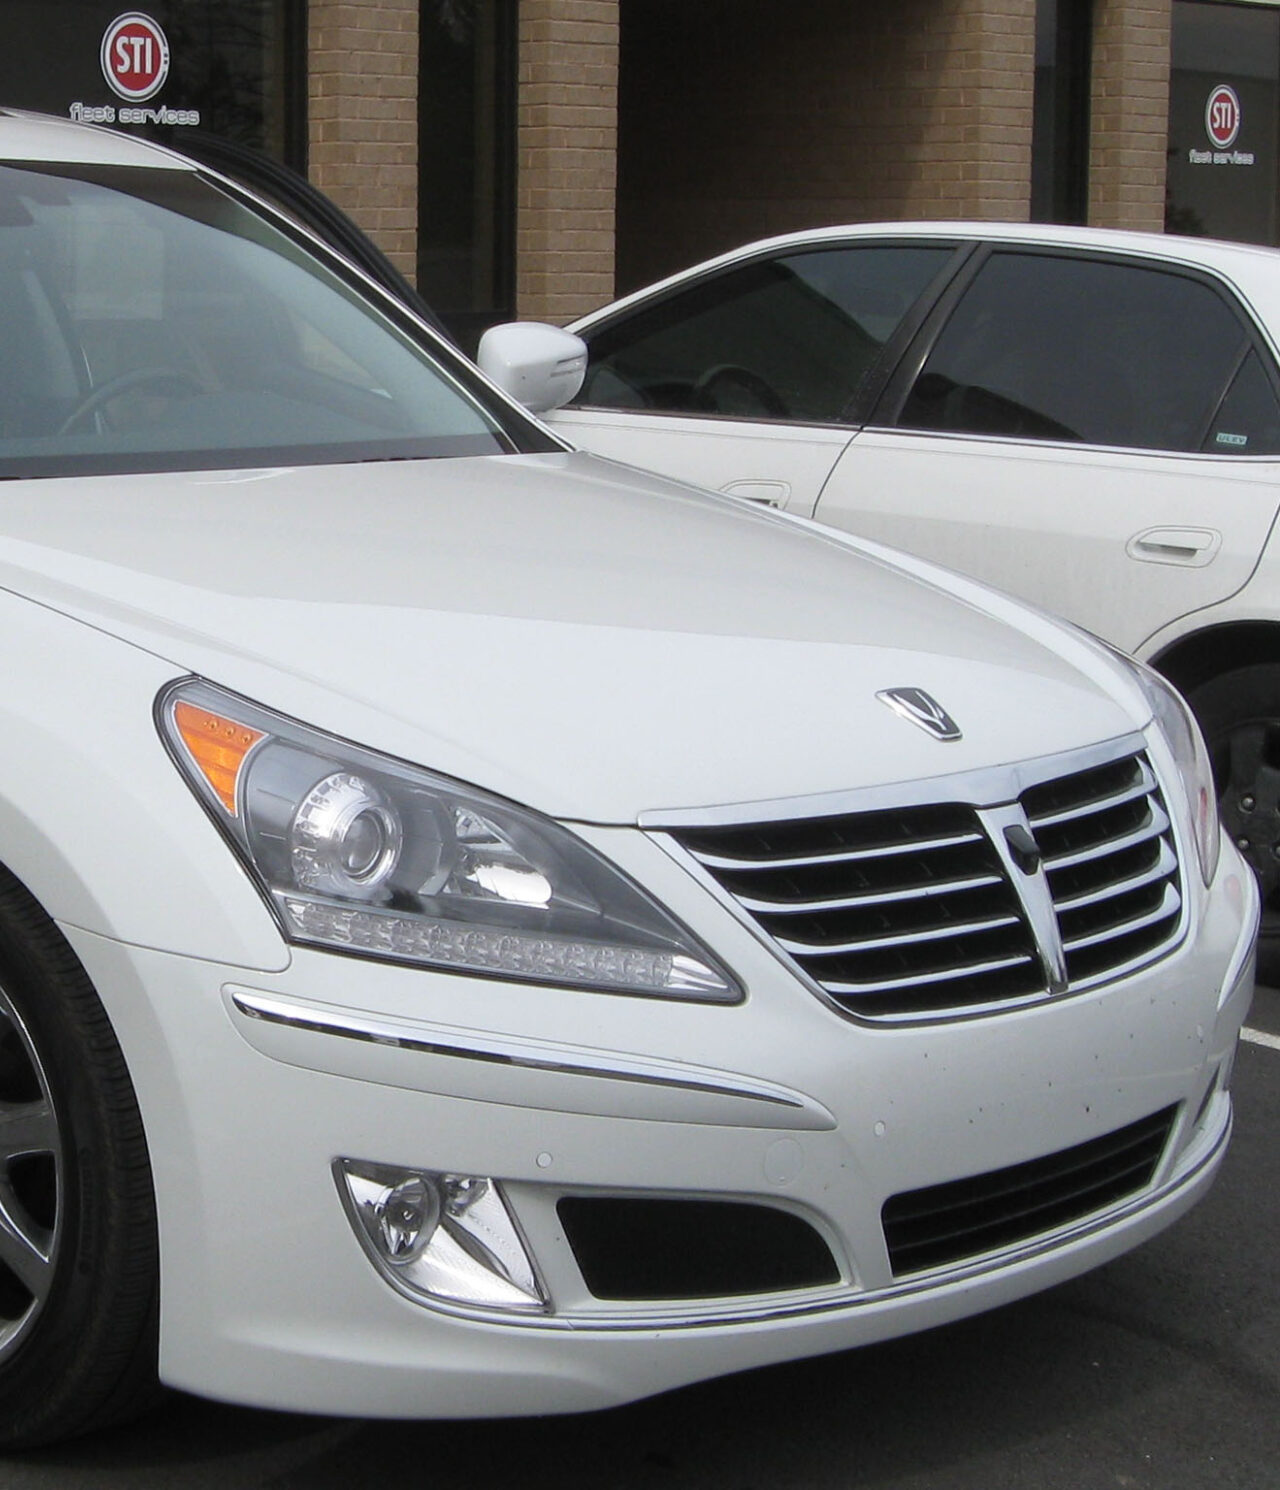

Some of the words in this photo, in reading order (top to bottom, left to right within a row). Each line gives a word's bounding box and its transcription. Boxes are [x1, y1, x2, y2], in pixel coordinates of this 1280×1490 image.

[115, 36, 152, 74] STI
[70, 102, 115, 122] fleet
[120, 105, 200, 125] services
[1213, 102, 1231, 129] STI
